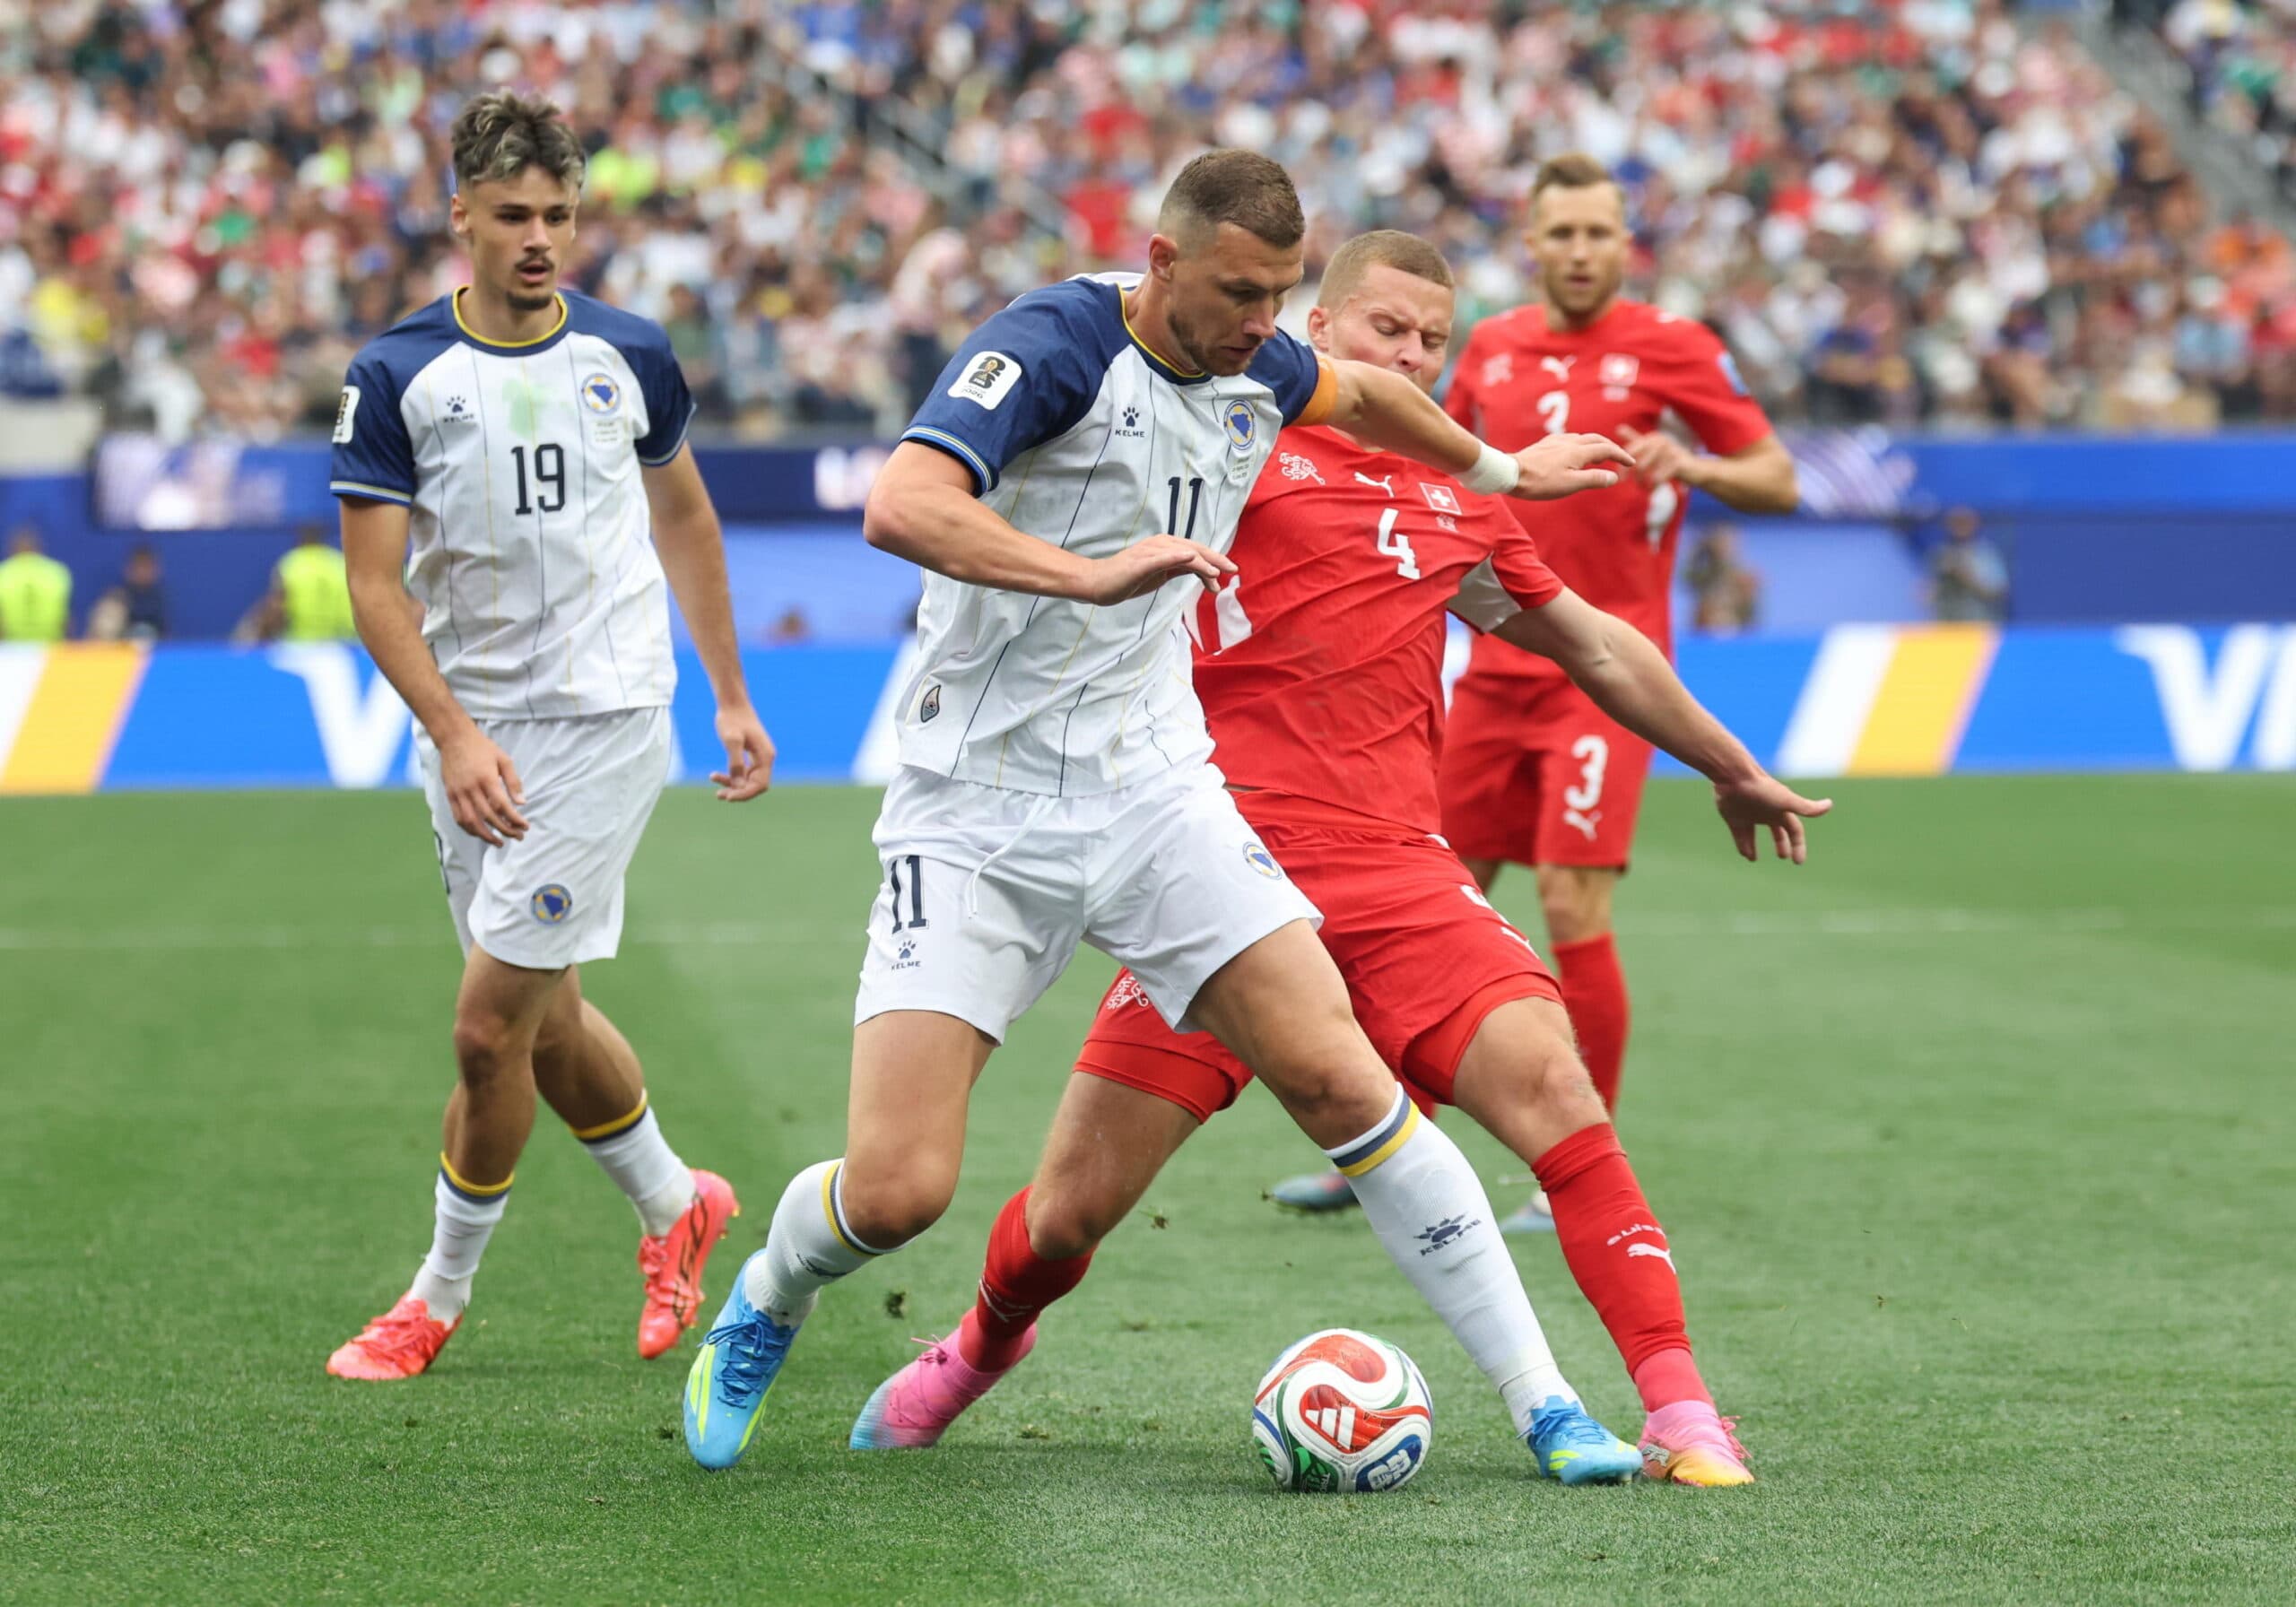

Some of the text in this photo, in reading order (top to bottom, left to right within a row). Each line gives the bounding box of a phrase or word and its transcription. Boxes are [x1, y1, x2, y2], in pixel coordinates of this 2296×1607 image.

[1115, 429, 1145, 439] KELME
[510, 443, 566, 516] 19
[1168, 476, 1204, 539] 11
[1377, 507, 1421, 580] 4
[1563, 734, 1609, 812] 3
[891, 855, 927, 934] 11
[891, 960, 921, 971] KELME
